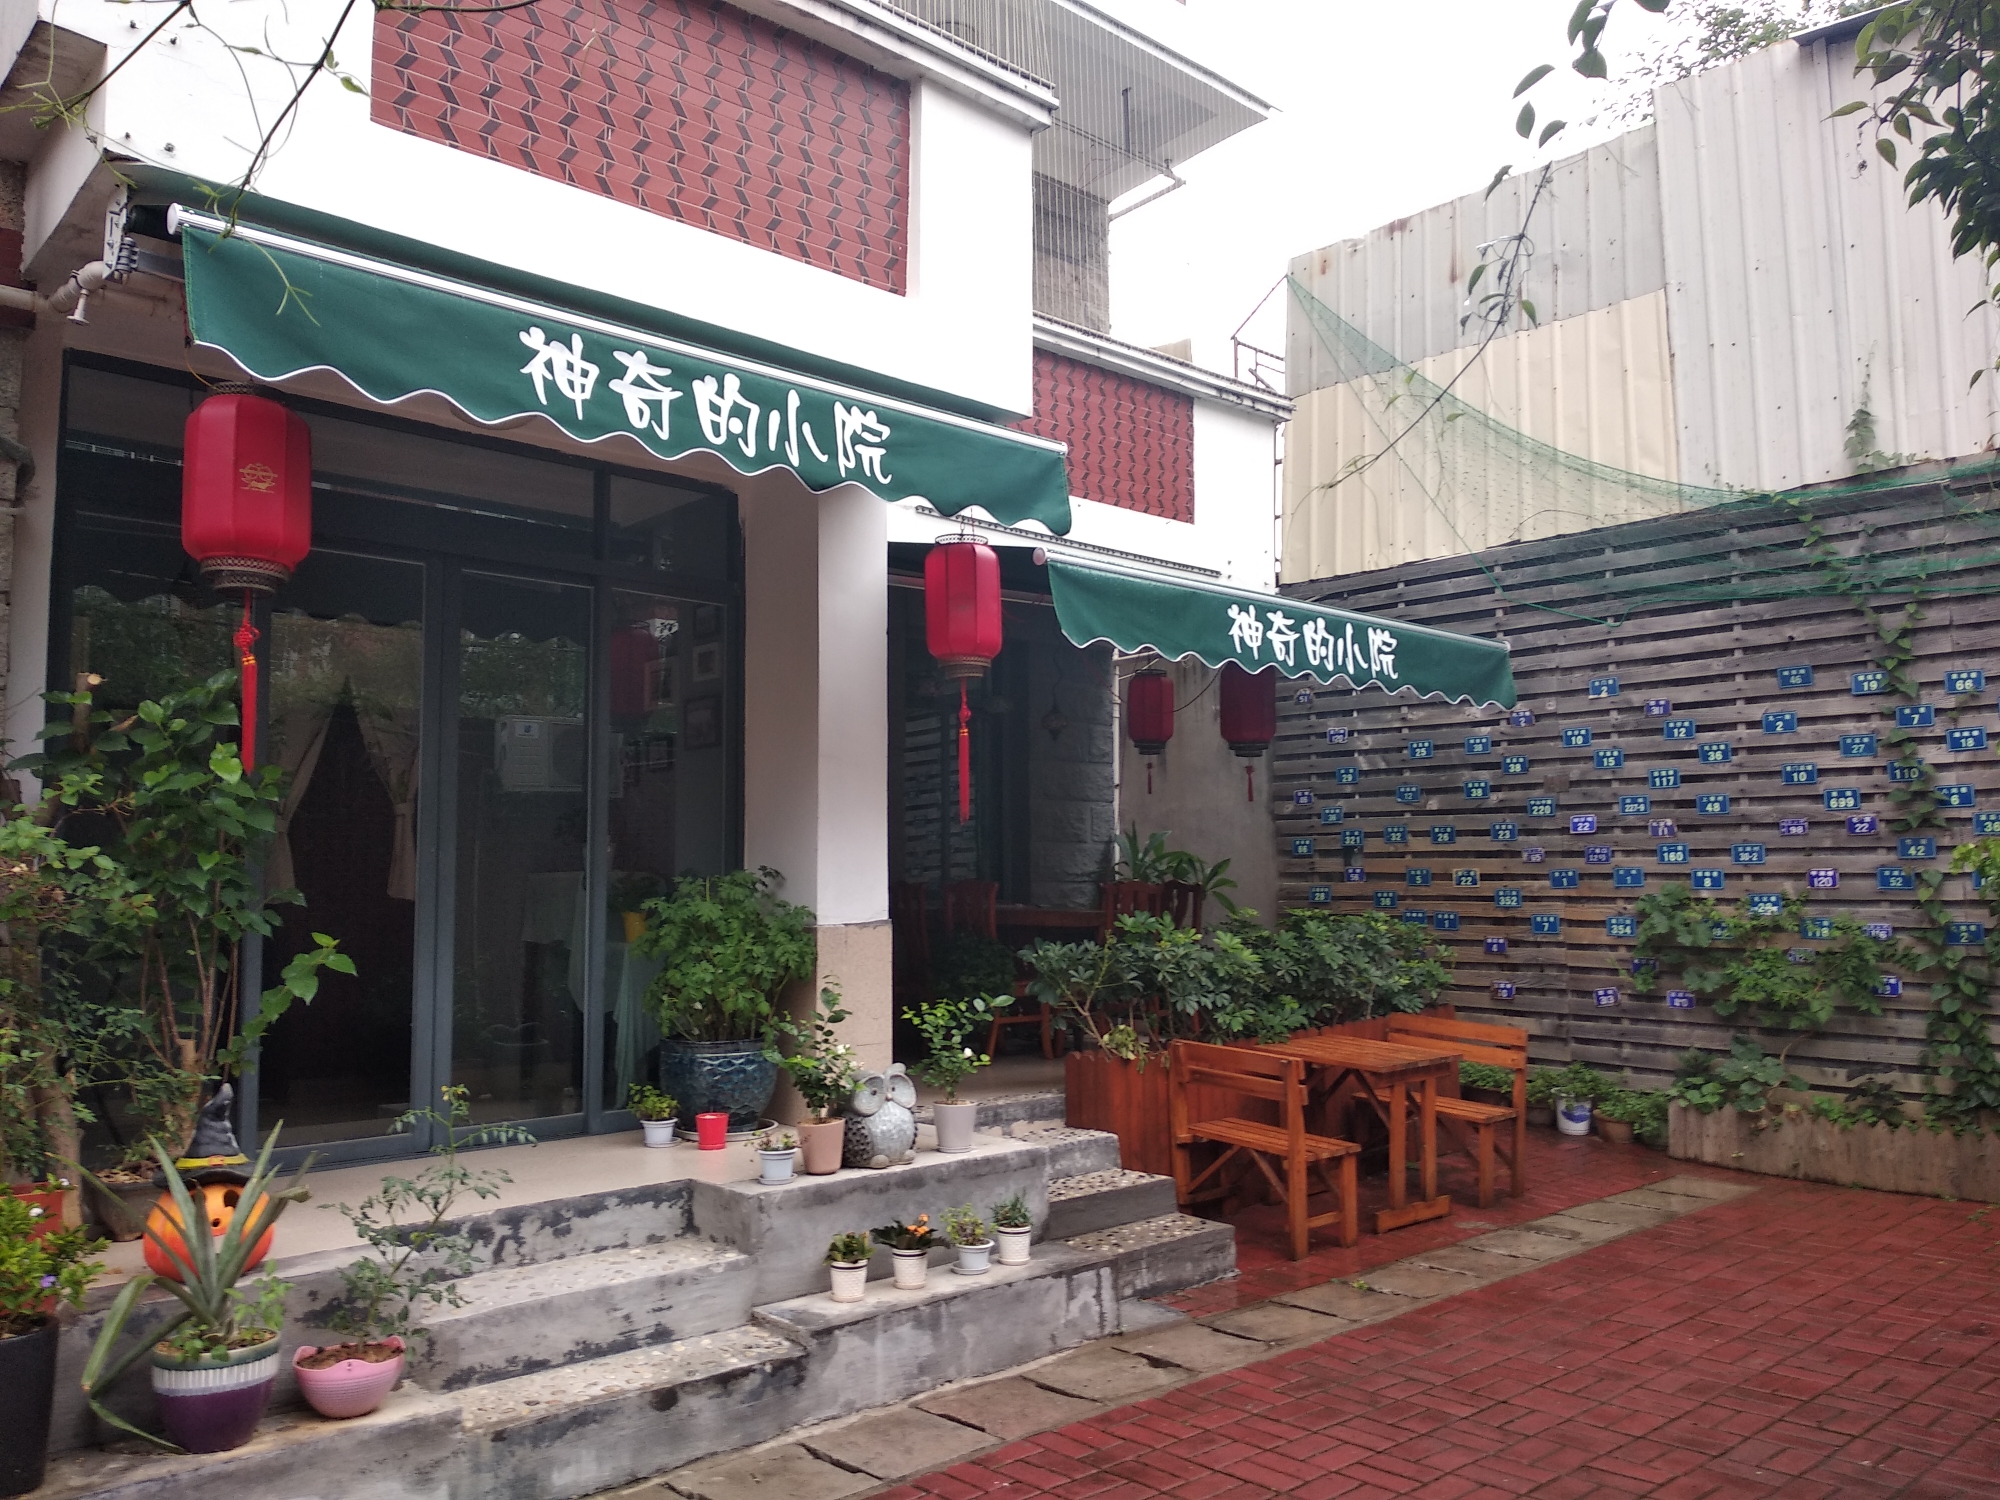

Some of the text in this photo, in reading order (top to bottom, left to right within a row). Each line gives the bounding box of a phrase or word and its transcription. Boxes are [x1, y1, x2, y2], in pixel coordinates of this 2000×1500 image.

[519, 326, 892, 484] 神奇的小院
[1227, 604, 1398, 679] 神奇的小院
[1862, 680, 1878, 691] 19
[1600, 686, 1608, 696] 2
[1910, 714, 1920, 725] 7
[1775, 721, 1784, 731] 2
[1672, 728, 1686, 737] 12
[1571, 736, 1584, 744] 10
[1960, 737, 1975, 748] 18
[1707, 750, 1723, 760] 36
[1602, 757, 1615, 766] 15
[1792, 771, 1807, 782] 10
[1894, 768, 1919, 779] 110
[1654, 777, 1674, 786] 117
[1950, 794, 1960, 805] 6
[1577, 822, 1590, 831] 22
[1908, 845, 1926, 856] 42
[1562, 878, 1568, 886] 1
[1626, 876, 1631, 885] 1
[1813, 877, 1833, 887] 120
[1889, 877, 1903, 887] 52
[1444, 920, 1449, 928] 1
[1542, 923, 1549, 932] 7
[1960, 932, 1969, 943] 2
